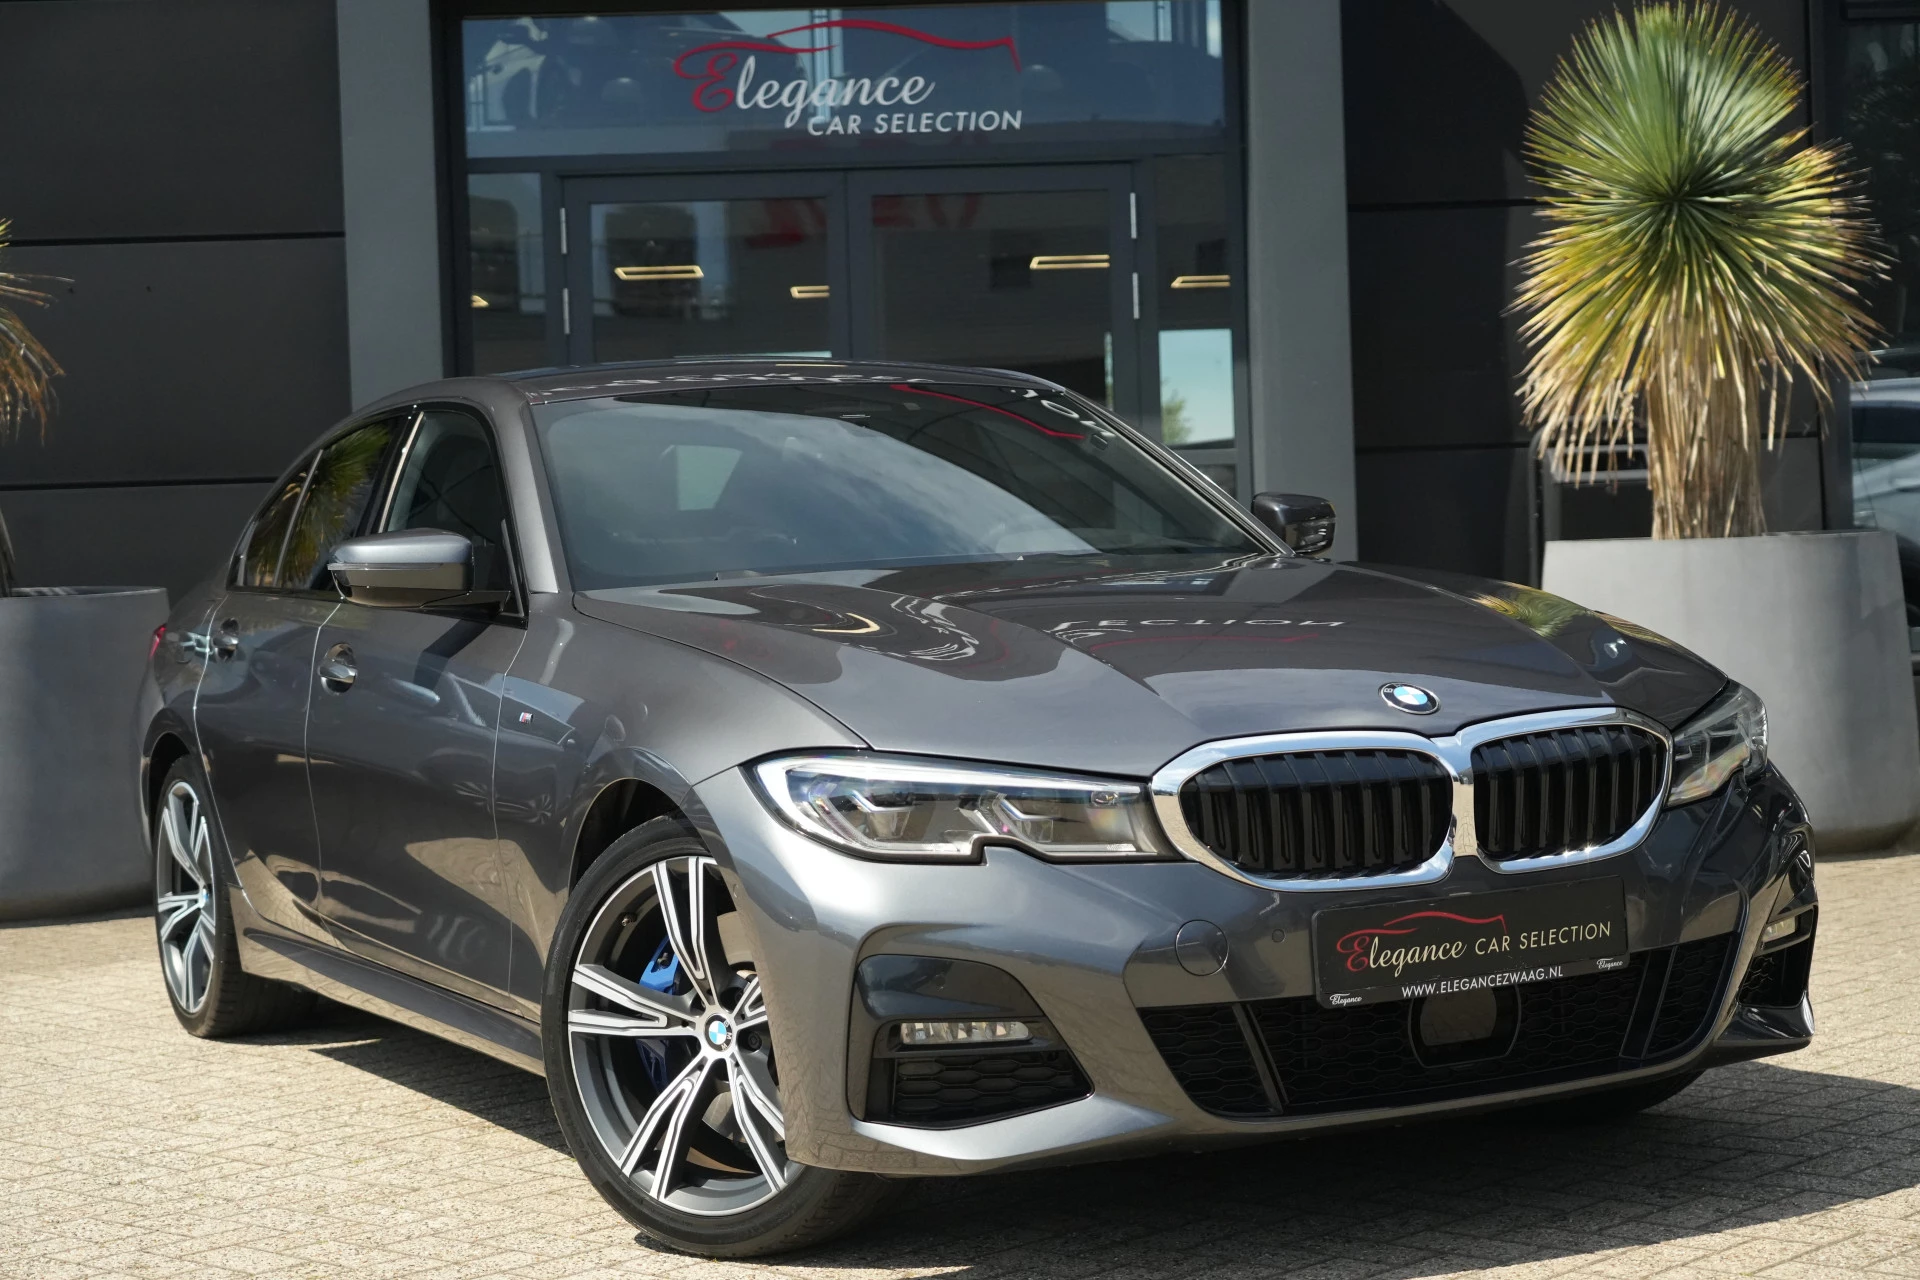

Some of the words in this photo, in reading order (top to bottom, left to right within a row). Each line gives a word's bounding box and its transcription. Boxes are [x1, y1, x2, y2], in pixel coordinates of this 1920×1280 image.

[673, 42, 936, 128] Elegance
[807, 115, 861, 136] CAR
[874, 110, 1022, 133] SELECTION
[1336, 928, 1467, 977] Elegance
[1475, 936, 1510, 955] CAR
[1520, 921, 1611, 949] SELECTION
[1402, 966, 1563, 998] WWW.ELEGANCEZWAAG.NL
[1330, 992, 1362, 1006] Elegance
